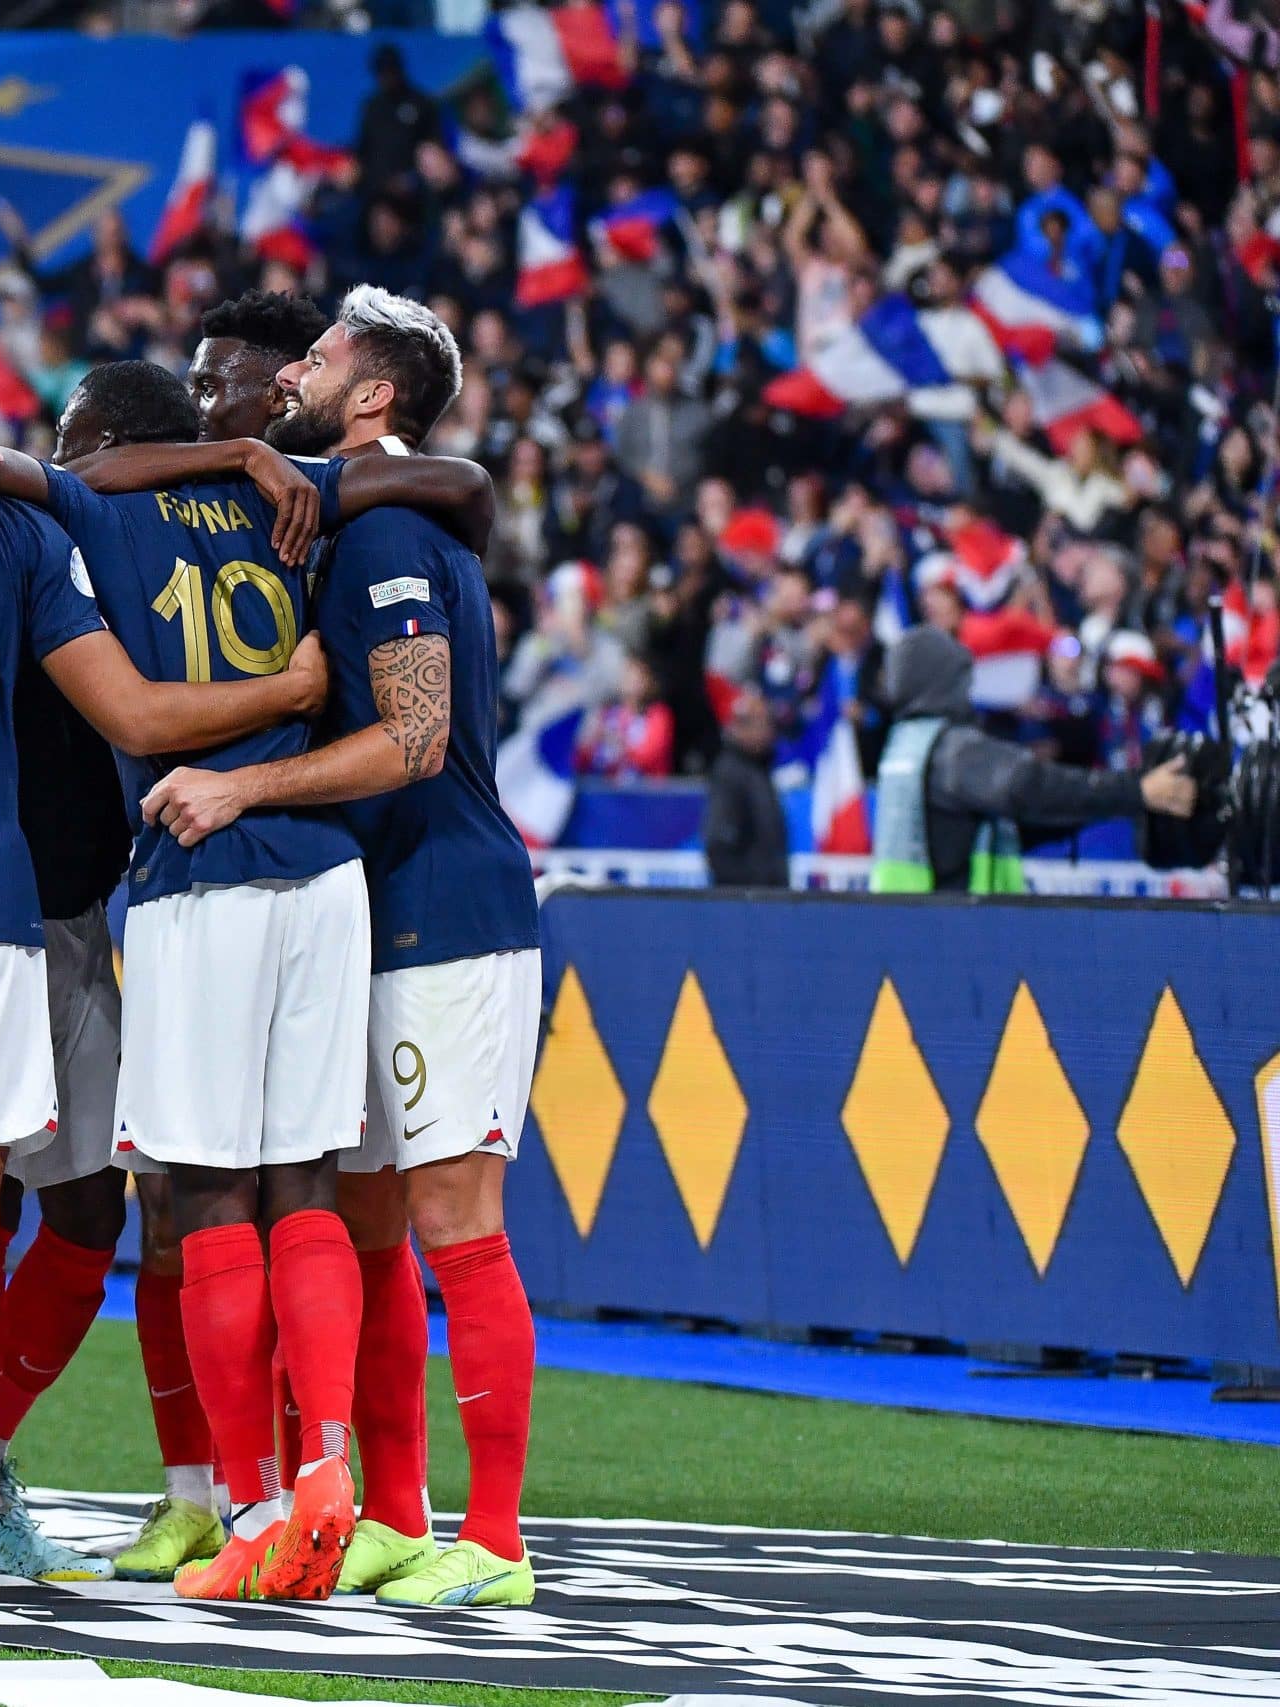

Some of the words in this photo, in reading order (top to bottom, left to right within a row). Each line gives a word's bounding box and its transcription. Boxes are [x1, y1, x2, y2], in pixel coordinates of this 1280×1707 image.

[154, 491, 253, 535] FONA
[372, 583, 428, 600] FOUNDATION
[392, 1040, 428, 1112] 9
